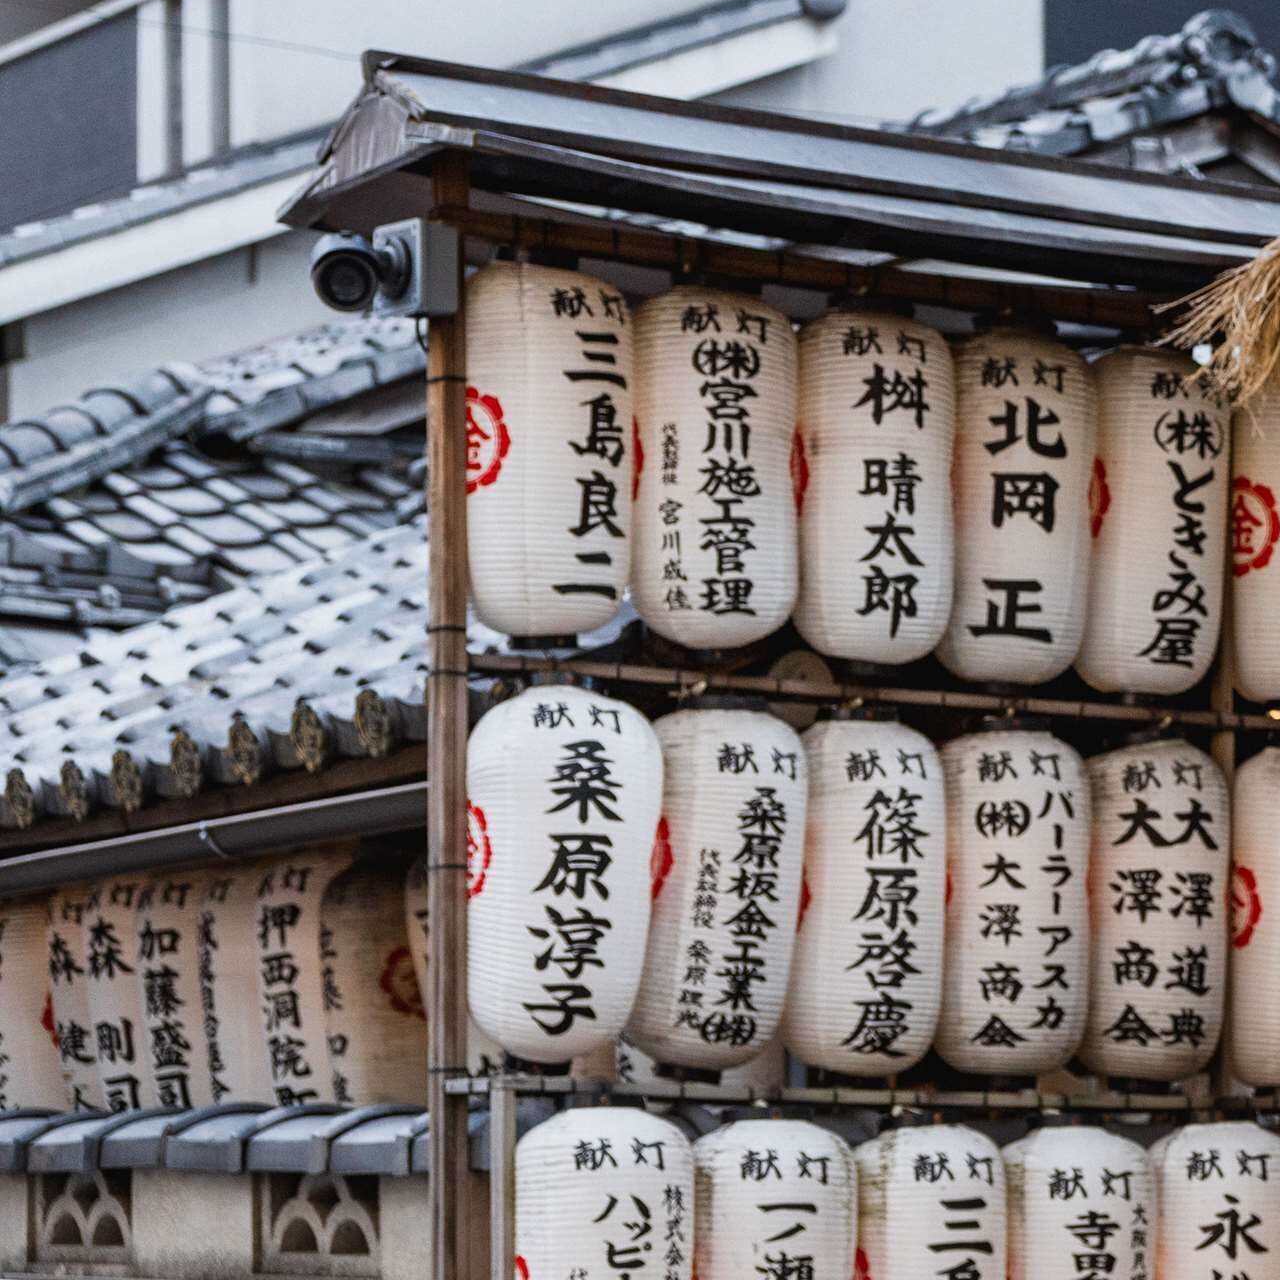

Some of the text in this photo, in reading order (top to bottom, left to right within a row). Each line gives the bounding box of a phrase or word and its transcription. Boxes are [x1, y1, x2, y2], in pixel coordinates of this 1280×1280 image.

[550, 287, 626, 324] 献灯
[681, 303, 769, 344] 献灯
[842, 326, 926, 363] 献灯
[980, 357, 1067, 394] 献灯
[552, 329, 628, 600] 三島良二
[533, 703, 621, 735] 献灯
[716, 743, 798, 781] 献灯
[846, 749, 929, 783] 献灯
[977, 749, 1061, 785] 献灯
[1122, 759, 1204, 793] 献灯
[522, 739, 624, 1037] 桑原淳子
[1103, 798, 1170, 1047] 大澤商会
[1160, 798, 1219, 1047] 大澤道典
[573, 1137, 666, 1172] 献灯
[740, 1148, 832, 1186] 献灯
[913, 1152, 994, 1187] 献灯
[1186, 1149, 1273, 1183] 献灯
[1048, 1167, 1136, 1202] 献灯
[593, 1194, 654, 1280] ハッピ
